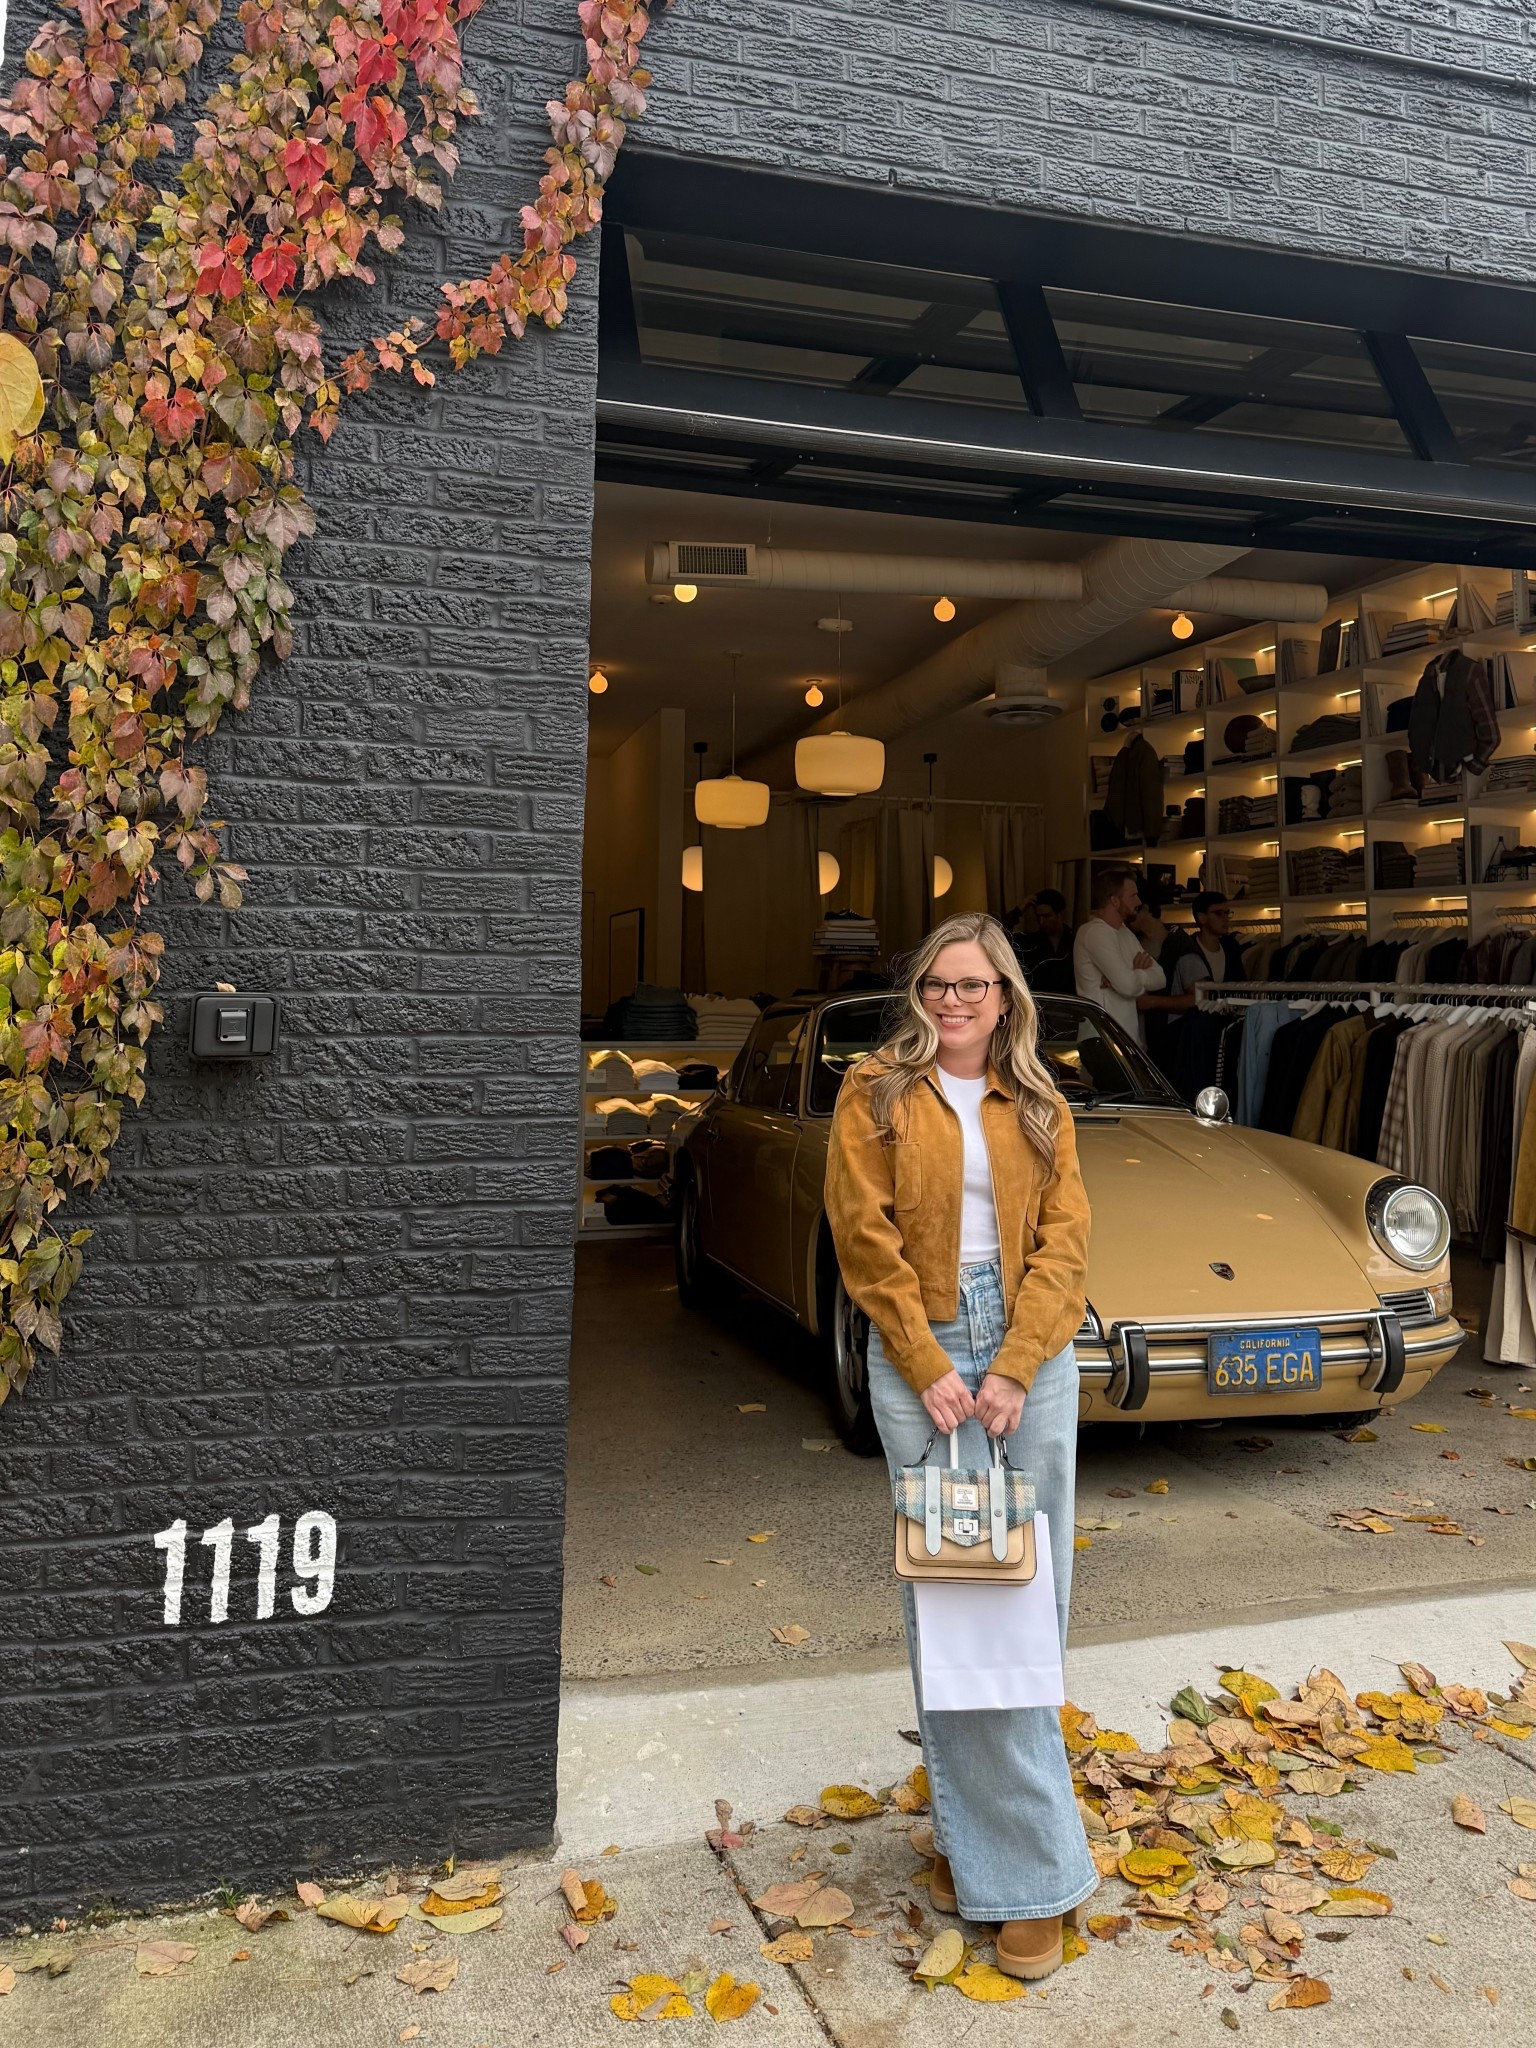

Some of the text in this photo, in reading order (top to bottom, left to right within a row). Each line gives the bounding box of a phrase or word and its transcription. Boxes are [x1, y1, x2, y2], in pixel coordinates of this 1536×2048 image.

[1240, 1338, 1290, 1349] CALIFORNIA
[1215, 1352, 1314, 1386] 635 EGA
[153, 1510, 337, 1625] 1119
